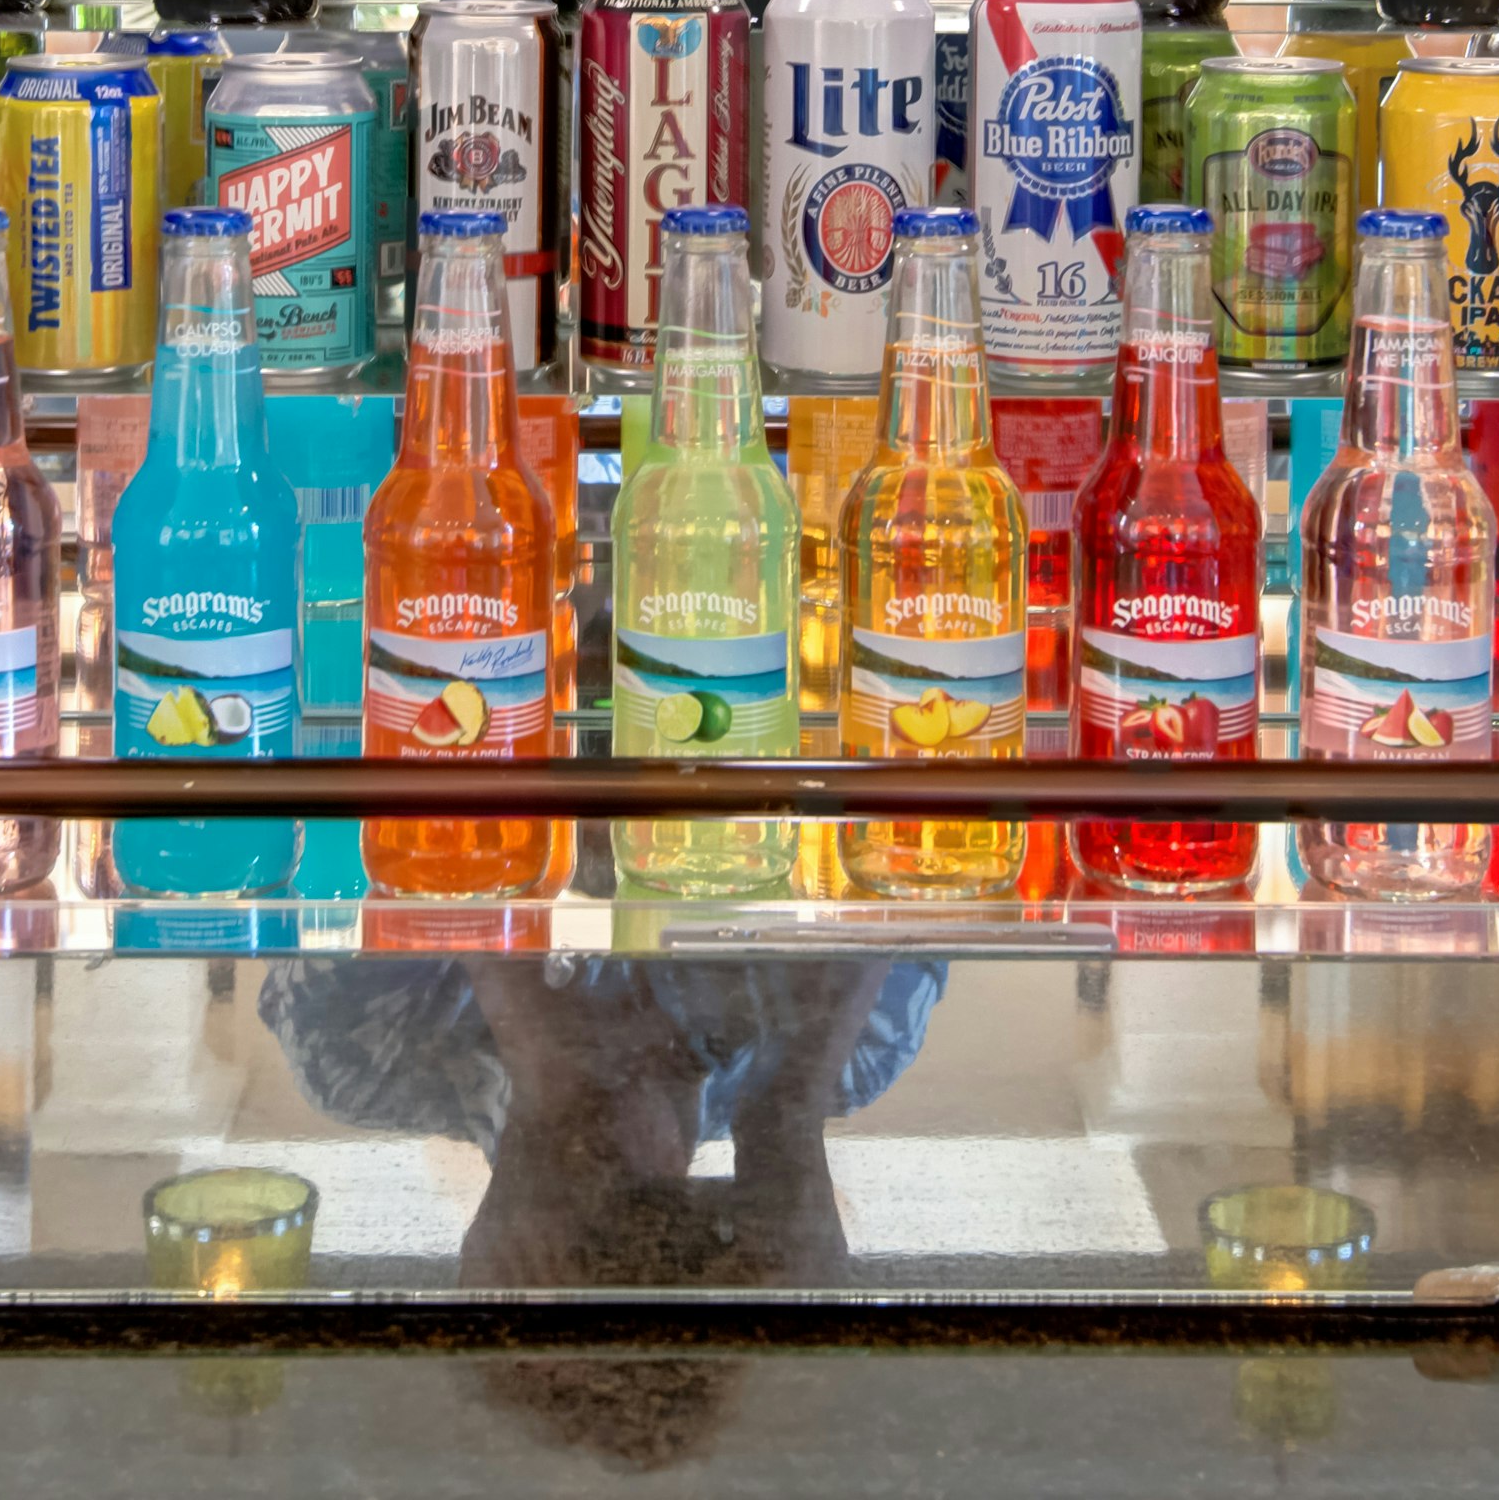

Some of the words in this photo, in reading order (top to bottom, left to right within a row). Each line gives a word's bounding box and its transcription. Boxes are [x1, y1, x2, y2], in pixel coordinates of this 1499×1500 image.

[17, 78, 82, 100] ORIGINAL
[1018, 76, 1104, 121] Pabst
[425, 102, 464, 142] JIM
[469, 95, 532, 145] BEAM
[785, 61, 923, 158] Lite
[986, 128, 1043, 159] Blue
[1047, 122, 1133, 159] Ribbon
[28, 135, 59, 194] TEA
[581, 57, 626, 291] Yuengling
[1041, 162, 1087, 172] BEER
[228, 147, 335, 213] HAPPY
[812, 170, 848, 202] FINE
[478, 197, 523, 209] STRAIGHT
[1222, 192, 1259, 214] ALL
[1266, 190, 1306, 211] DAY
[1313, 192, 1338, 212] IPA
[248, 182, 342, 252] ERMIT
[807, 208, 819, 219] A
[102, 199, 125, 288] ORIGINAL
[295, 236, 318, 251] Pale
[322, 225, 339, 240] Ale
[29, 198, 61, 333] TWISTED
[834, 273, 882, 291] BEER
[1037, 260, 1086, 299] 16
[1238, 289, 1295, 301] SESSION
[276, 303, 337, 328] Bench
[175, 320, 241, 338] CALYPSO
[1131, 328, 1209, 347] STRAWBERRY
[177, 341, 241, 358] COLADA
[428, 340, 484, 354] PASSION
[912, 334, 968, 349] PEACH
[1372, 336, 1445, 353] JAMAICAN
[896, 351, 940, 368] FUZZY
[1138, 345, 1204, 364] DAIQUIRI
[1375, 354, 1399, 369] ME
[1401, 353, 1442, 369] HAPPY
[668, 363, 742, 377] MARGARITA
[142, 590, 264, 628] Seagram's
[396, 592, 519, 628] Seagram's
[639, 591, 759, 626] Seagram's
[885, 591, 1003, 628] Seagram's
[1112, 592, 1234, 629] Seagram's
[1350, 592, 1474, 629] Seagram's
[173, 618, 233, 633] ESCAPES
[429, 619, 489, 634] ESCAPES
[669, 619, 727, 632] ESCAPES
[918, 620, 976, 635] ESCAPES
[1146, 621, 1206, 636] ESCAPES
[1386, 621, 1444, 636] ESCAPES
